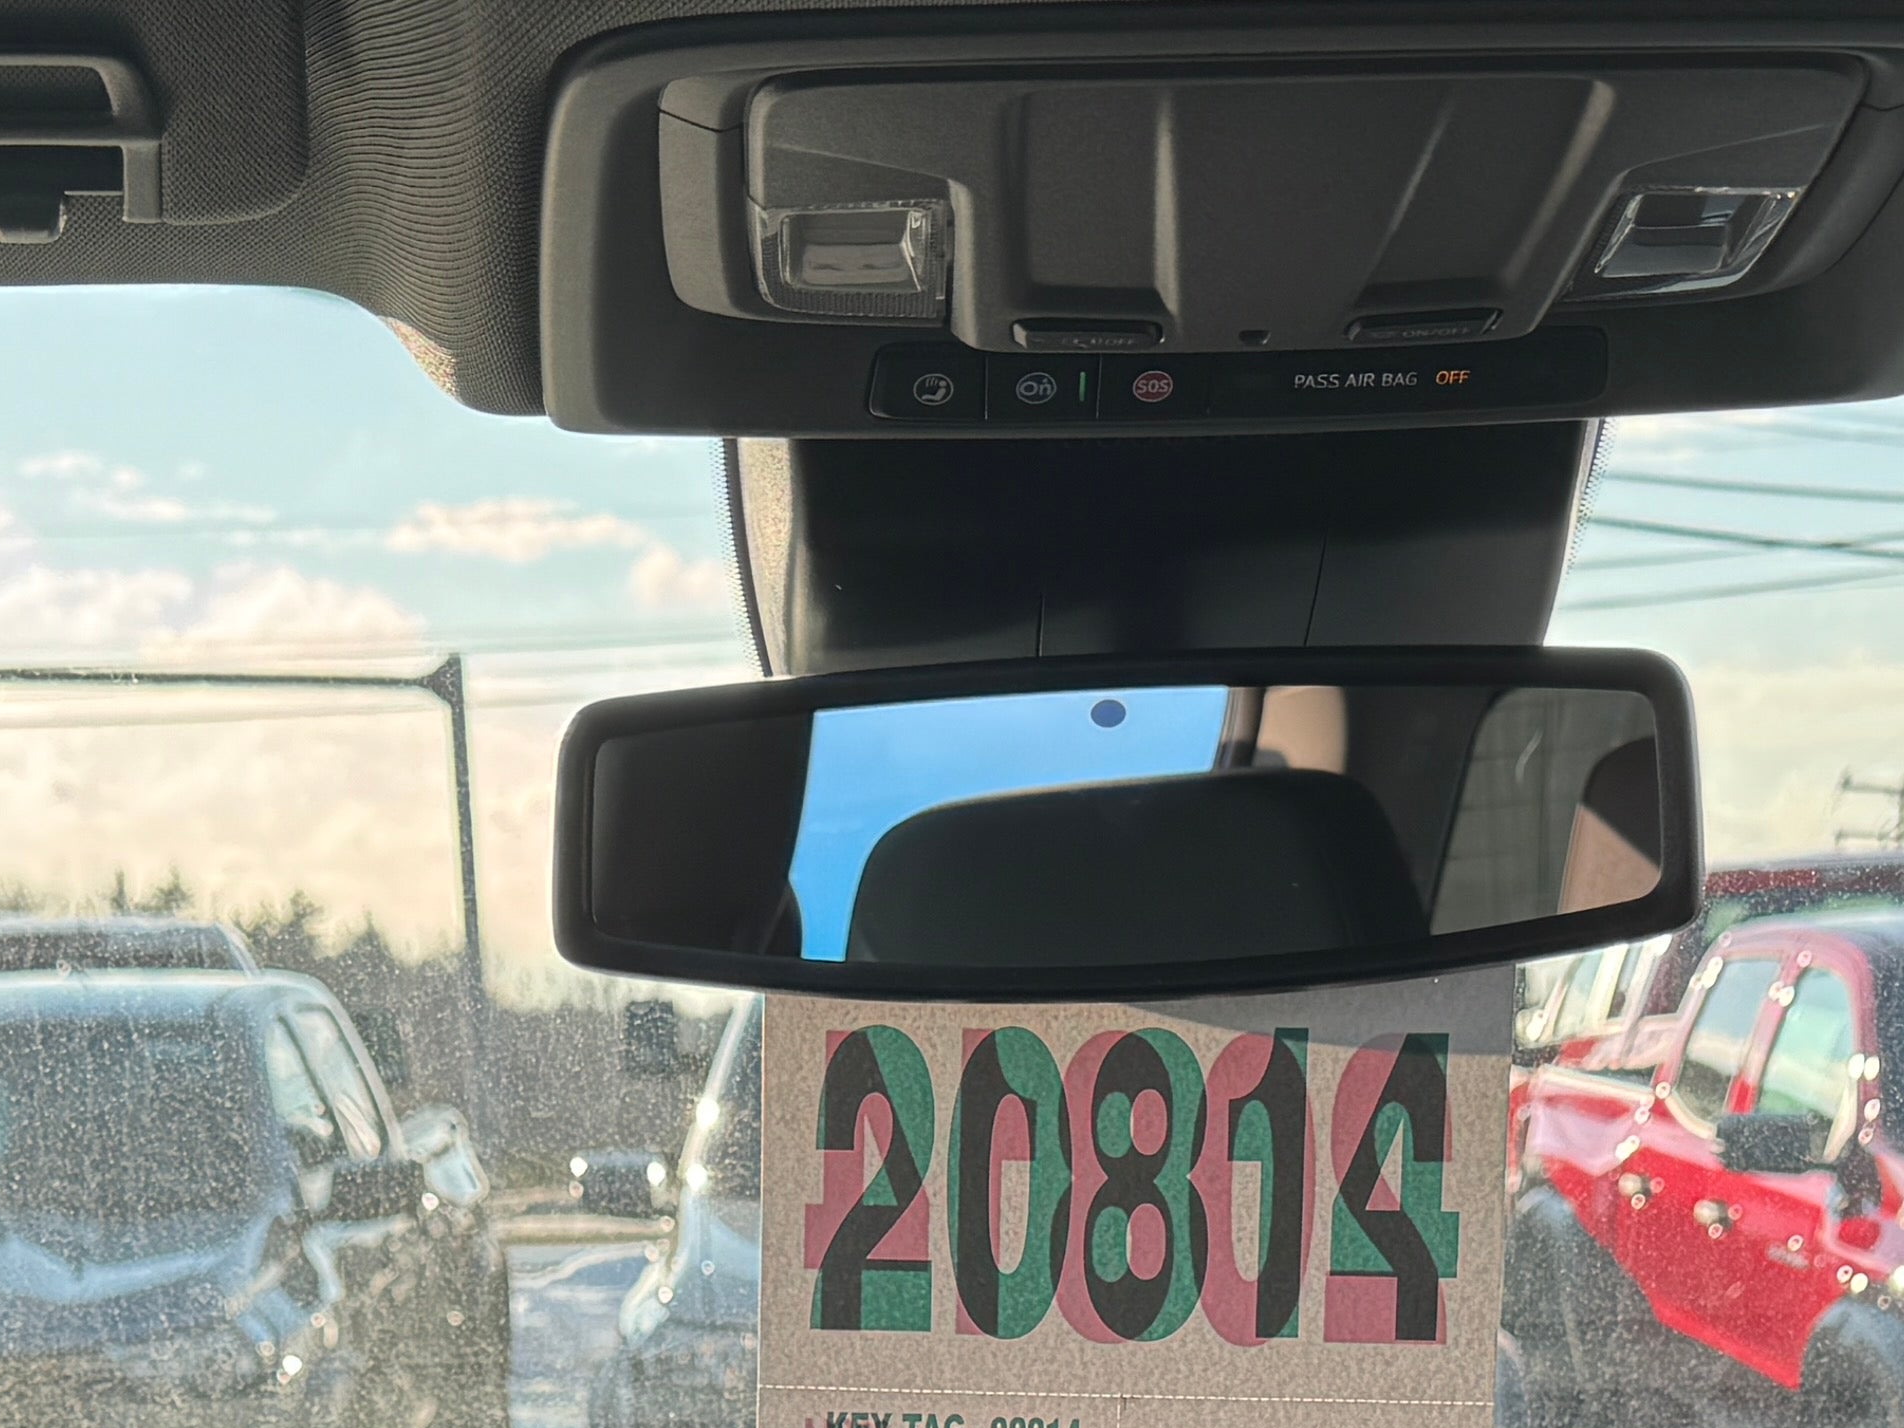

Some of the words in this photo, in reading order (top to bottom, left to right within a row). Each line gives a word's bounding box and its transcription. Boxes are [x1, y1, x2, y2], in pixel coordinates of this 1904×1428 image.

[1137, 378, 1171, 395] SOS
[1294, 374, 1340, 389] PASS
[1344, 372, 1376, 388] AIR
[1380, 371, 1418, 387] BAG
[1435, 369, 1471, 385] OFF
[810, 1024, 1460, 1342] 20814
